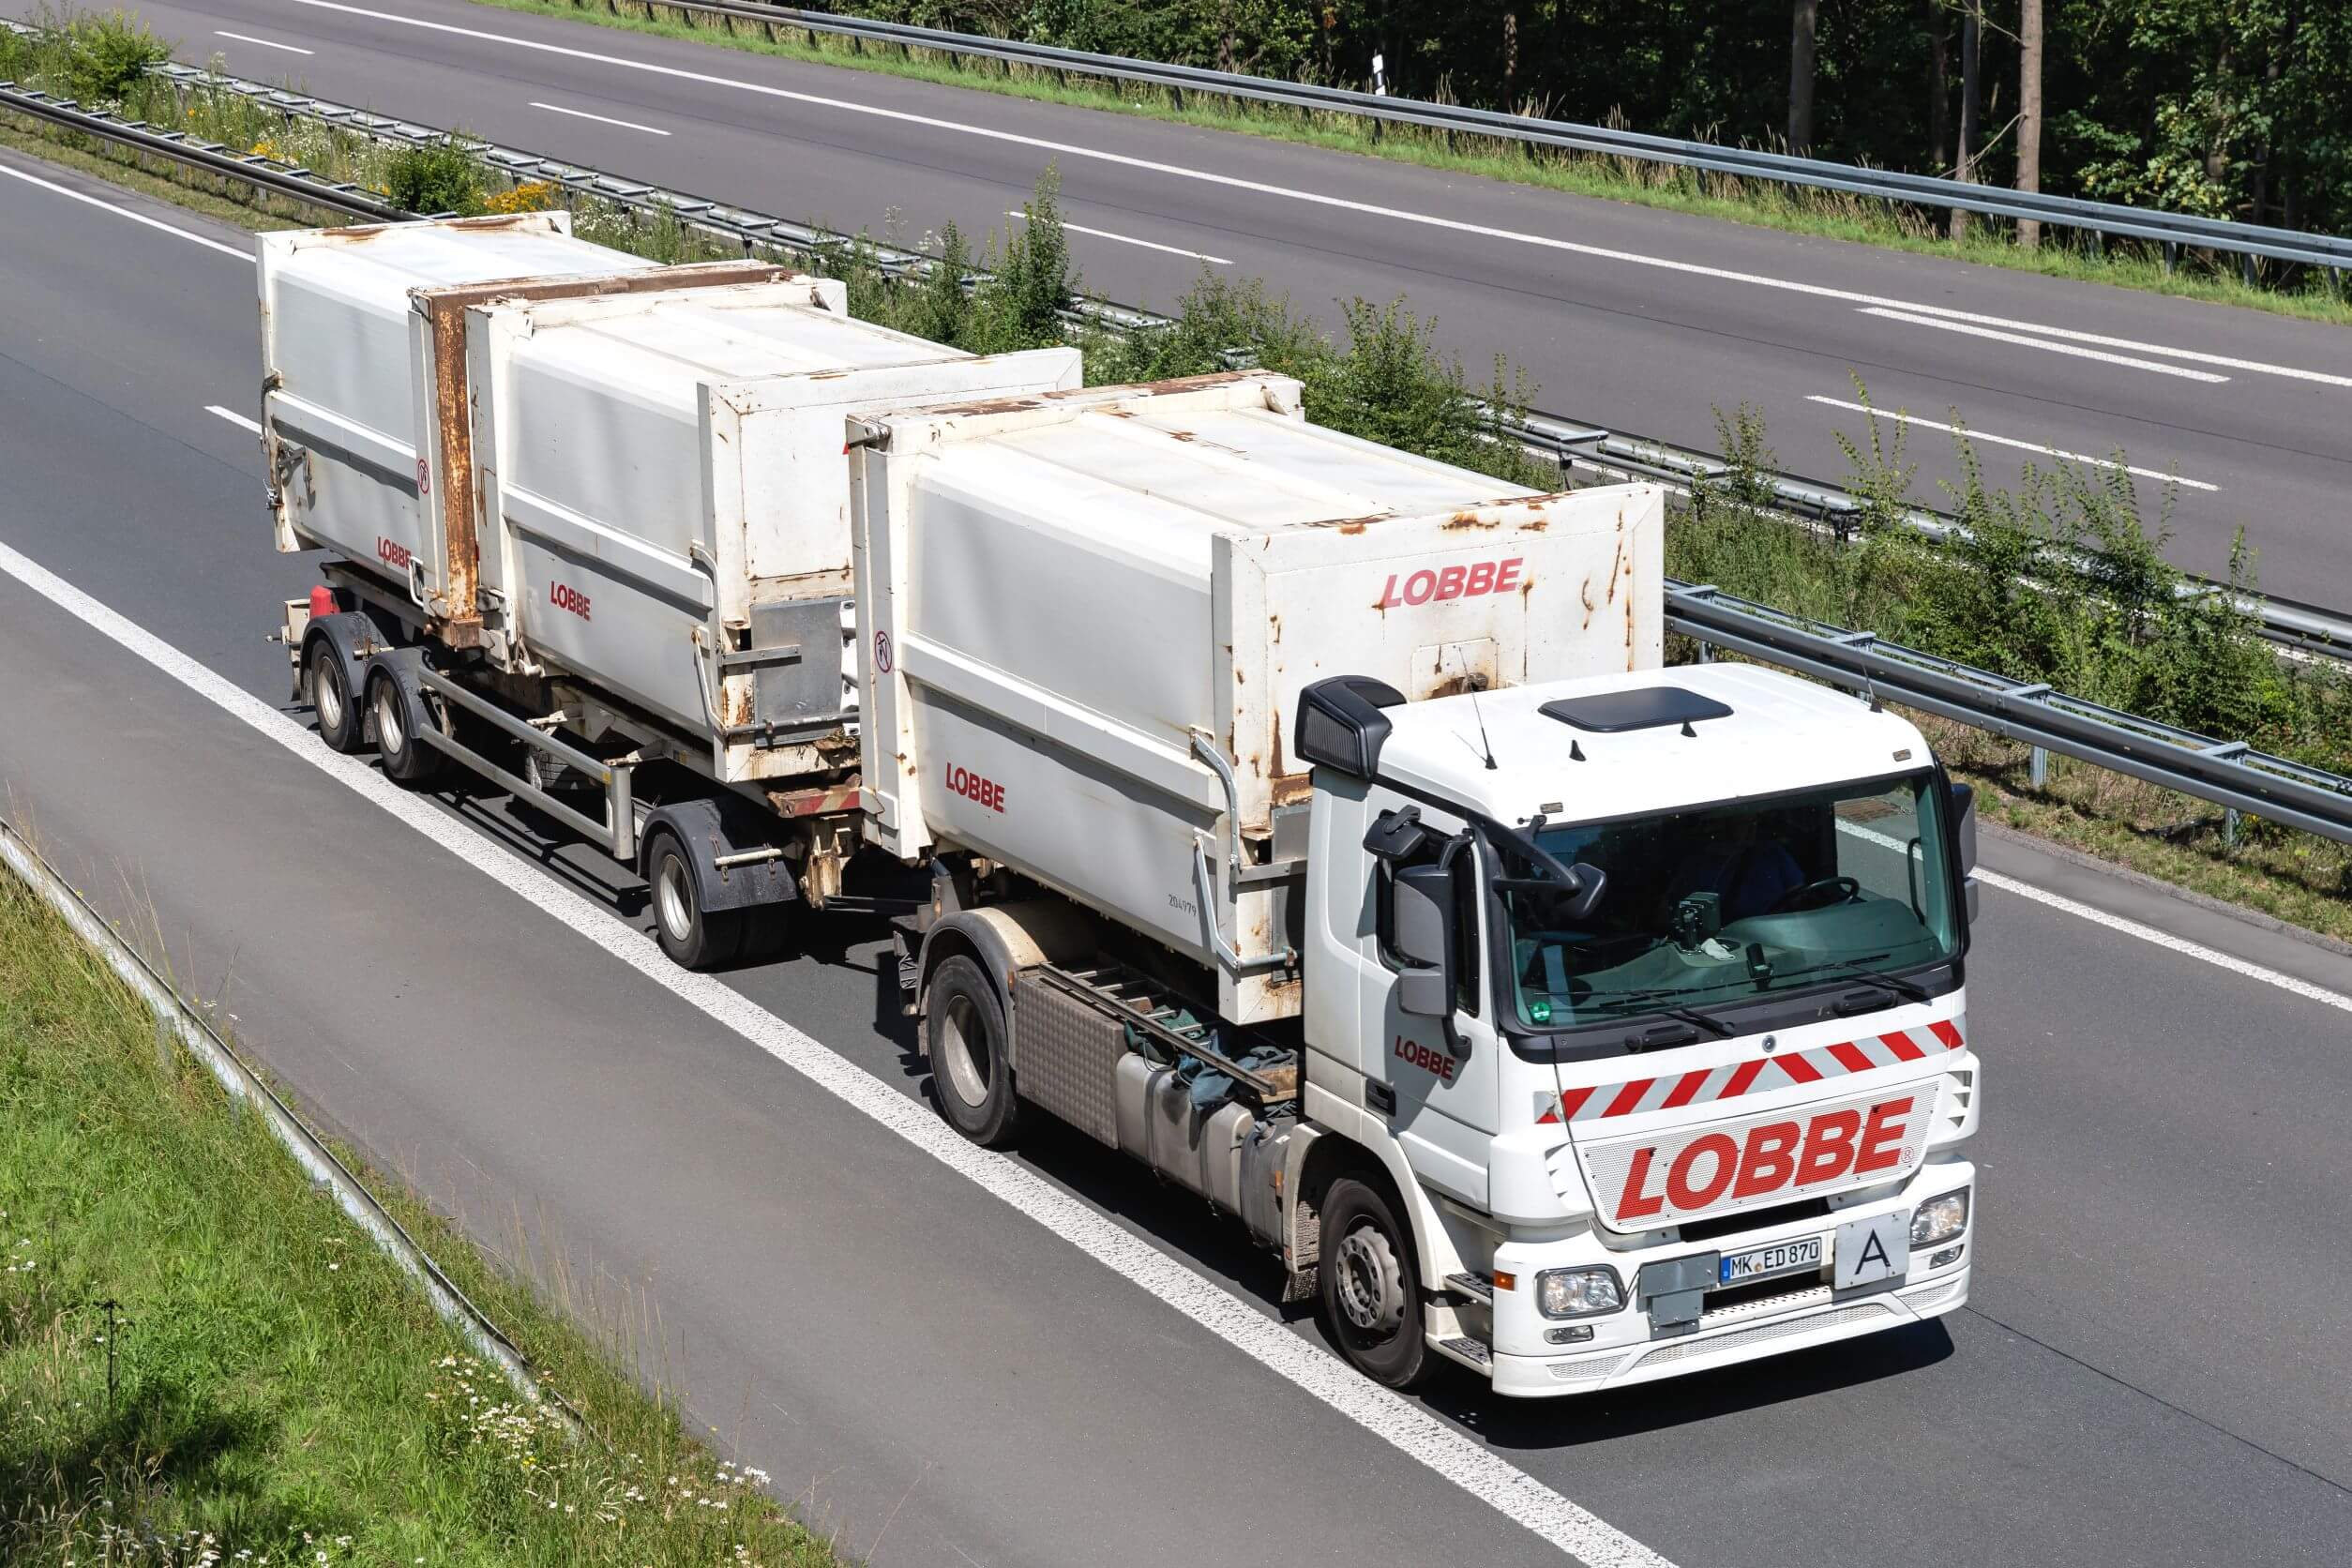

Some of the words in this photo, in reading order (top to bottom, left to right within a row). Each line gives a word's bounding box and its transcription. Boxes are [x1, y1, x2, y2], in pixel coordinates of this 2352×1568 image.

[550, 580, 591, 622] LOBBE
[1383, 557, 1524, 609] LOBBE
[945, 761, 1005, 814] LOBBE
[1395, 1034, 1455, 1081] LOBBE
[1615, 1095, 1915, 1220] LOBBE
[1731, 1255, 1753, 1276] MK
[1764, 1248, 1786, 1269] ED
[1788, 1241, 1819, 1263] 870
[1854, 1228, 1892, 1275] A
